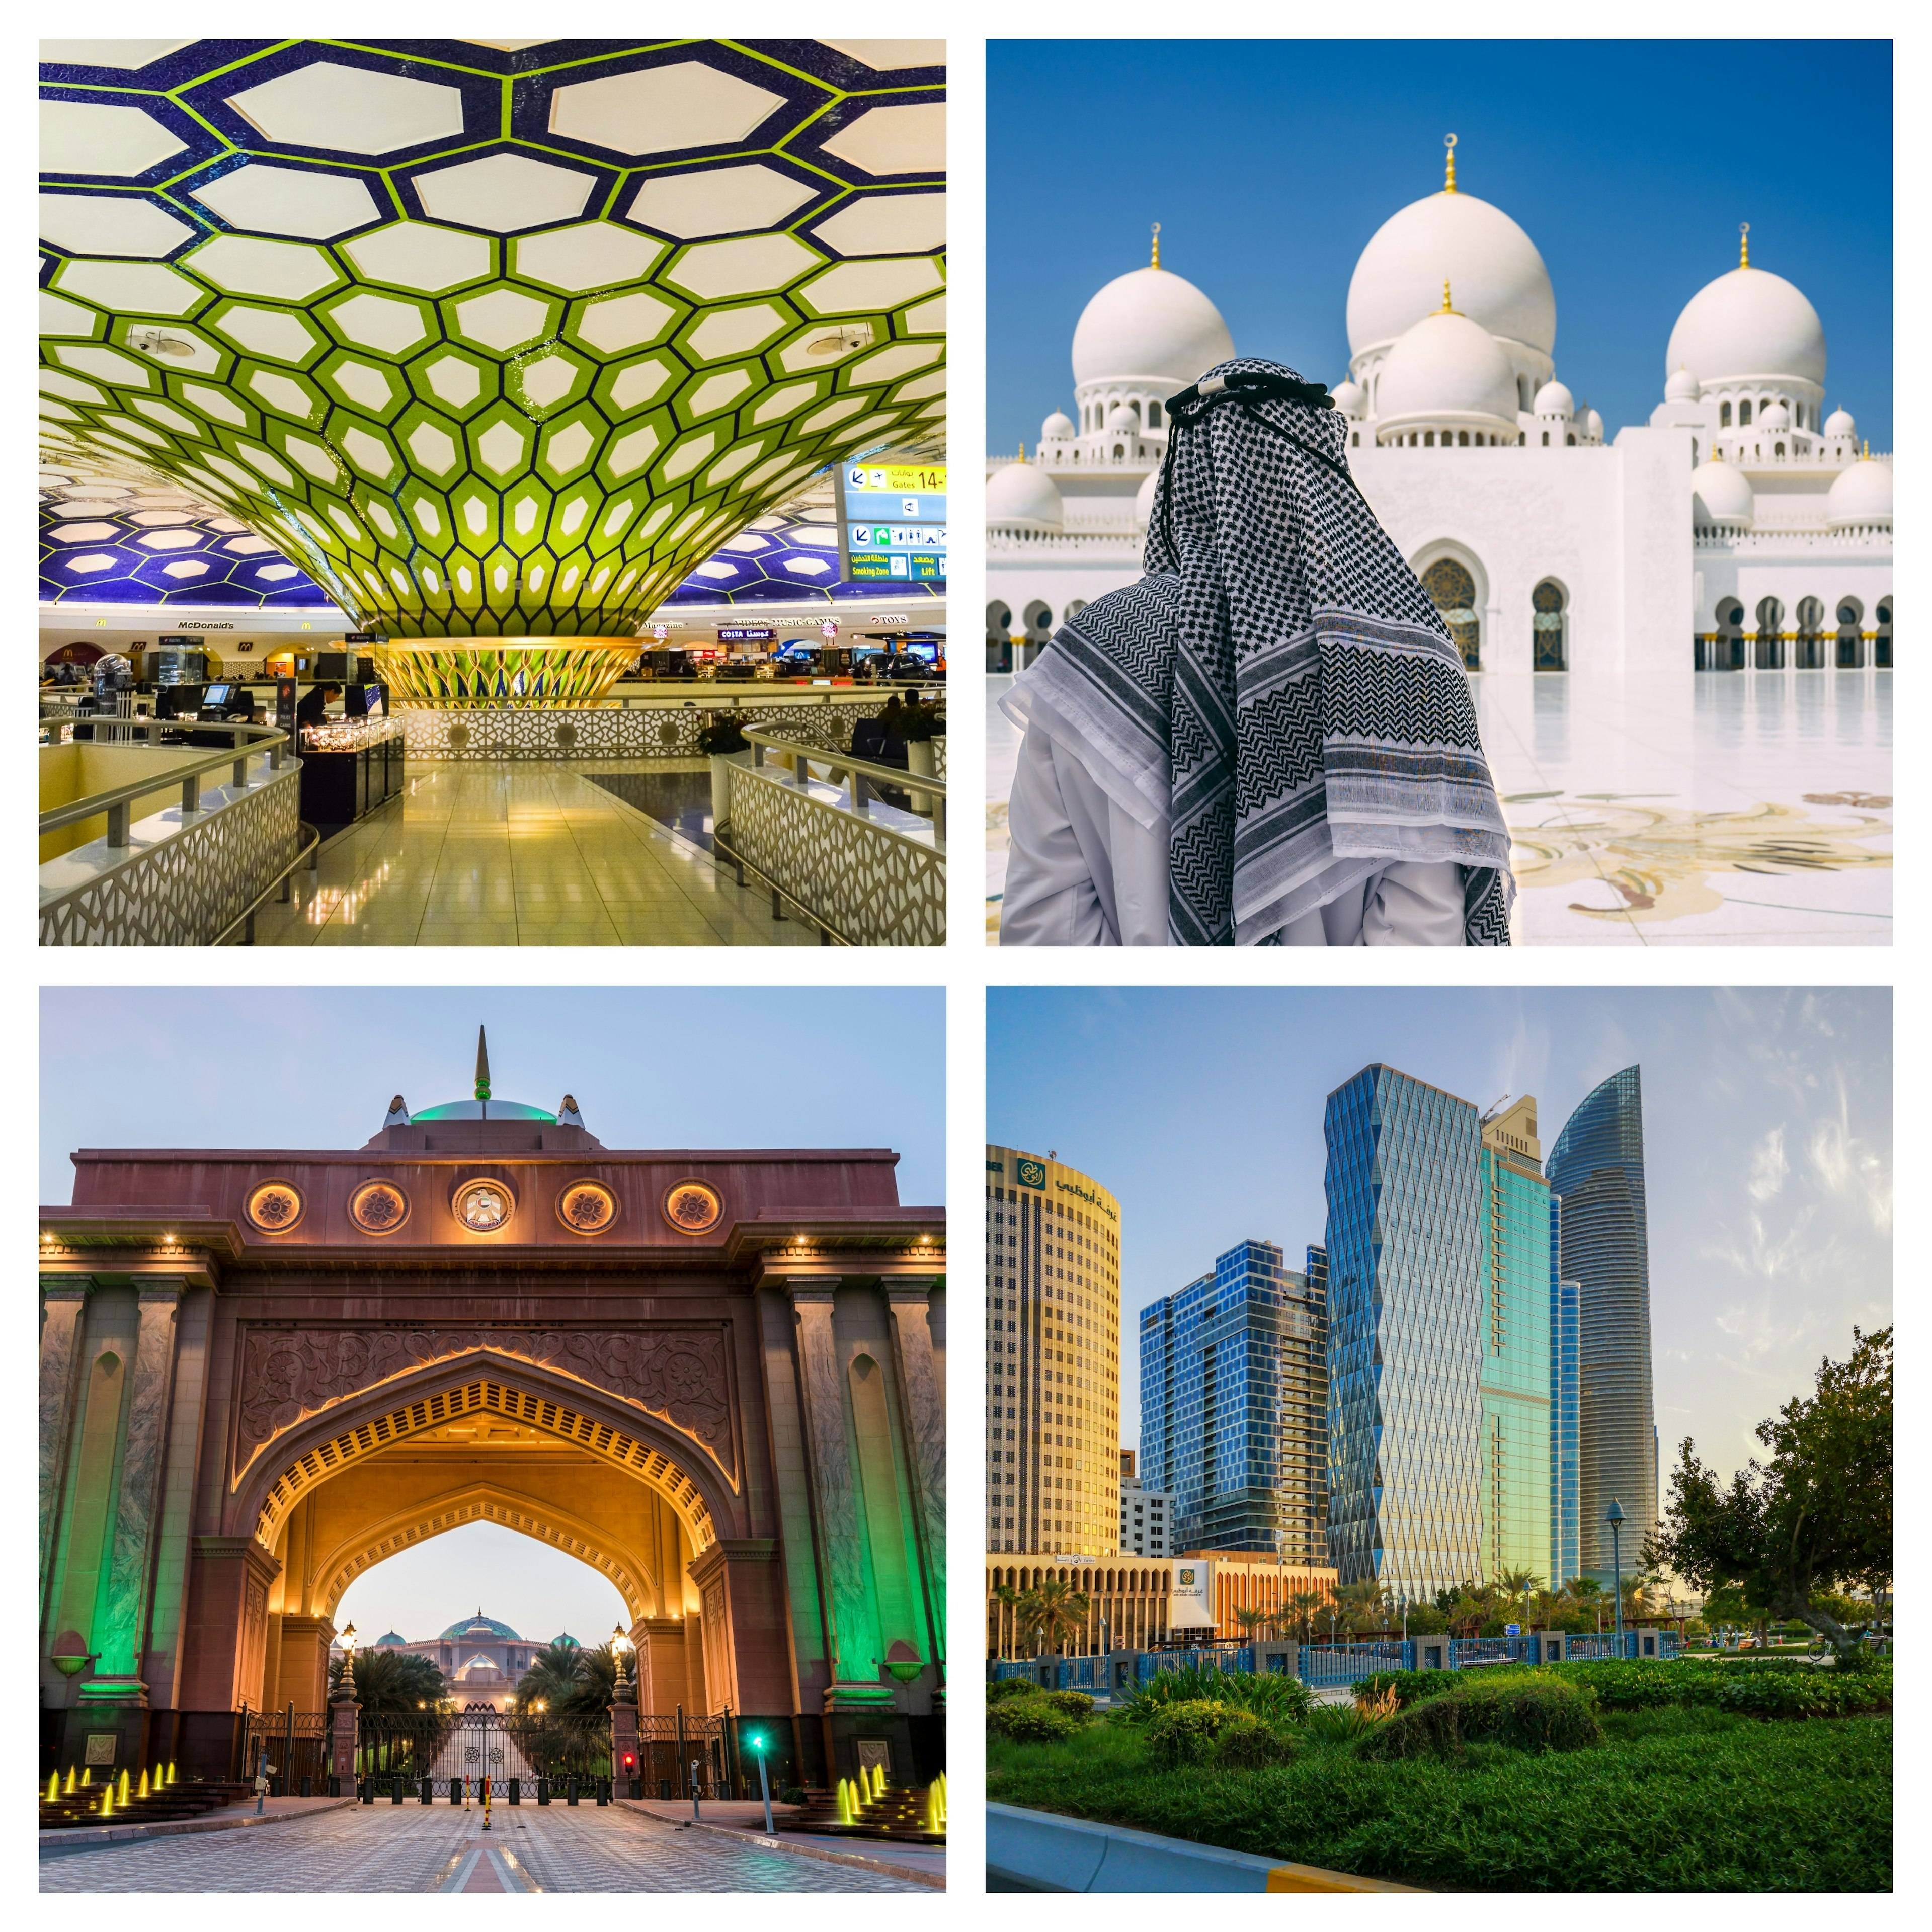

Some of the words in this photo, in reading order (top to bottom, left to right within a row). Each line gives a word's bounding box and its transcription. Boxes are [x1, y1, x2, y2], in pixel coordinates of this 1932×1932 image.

[892, 470, 913, 478] بوابات
[919, 472, 946, 489] 14-
[853, 567, 875, 577] Smoking
[876, 567, 889, 575] Zone
[922, 567, 935, 576] Lift
[880, 616, 907, 624] TOYS
